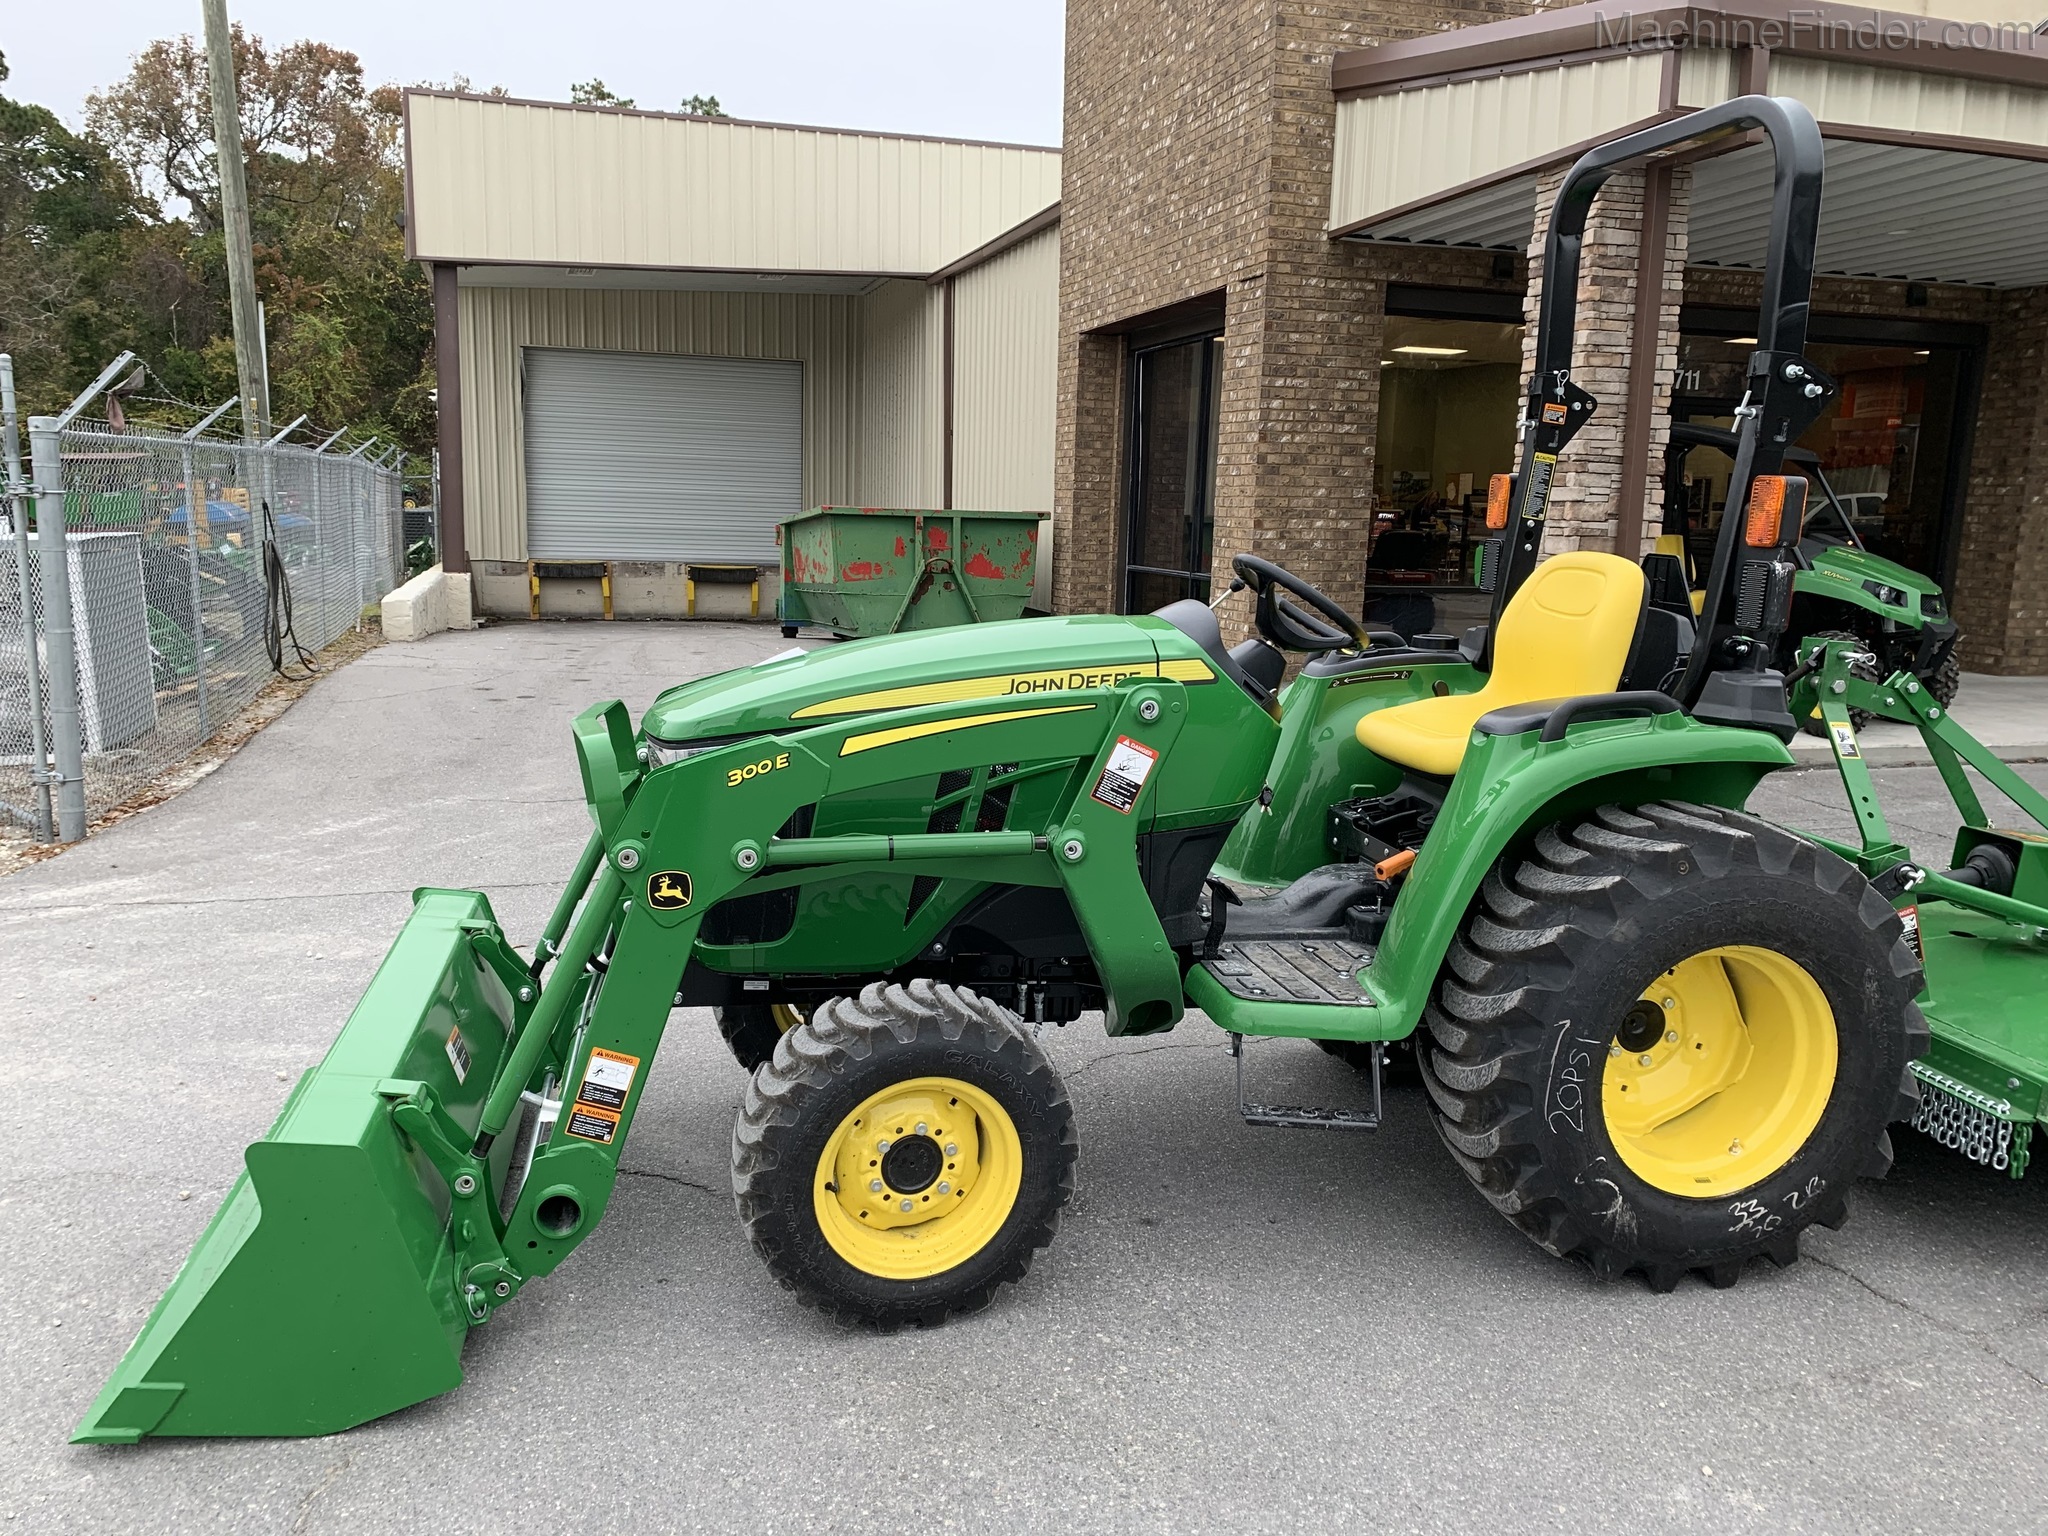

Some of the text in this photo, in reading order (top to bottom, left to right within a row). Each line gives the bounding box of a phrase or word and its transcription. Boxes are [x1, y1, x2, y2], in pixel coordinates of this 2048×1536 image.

[1675, 369, 1700, 390] 711
[1001, 671, 1142, 696] JOHN DEER
[1130, 742, 1154, 757] DANGER
[726, 751, 791, 788] 300 E
[603, 1051, 634, 1065] WARNING
[944, 1049, 1045, 1119] GALAXY
[585, 1108, 615, 1121] WARNING
